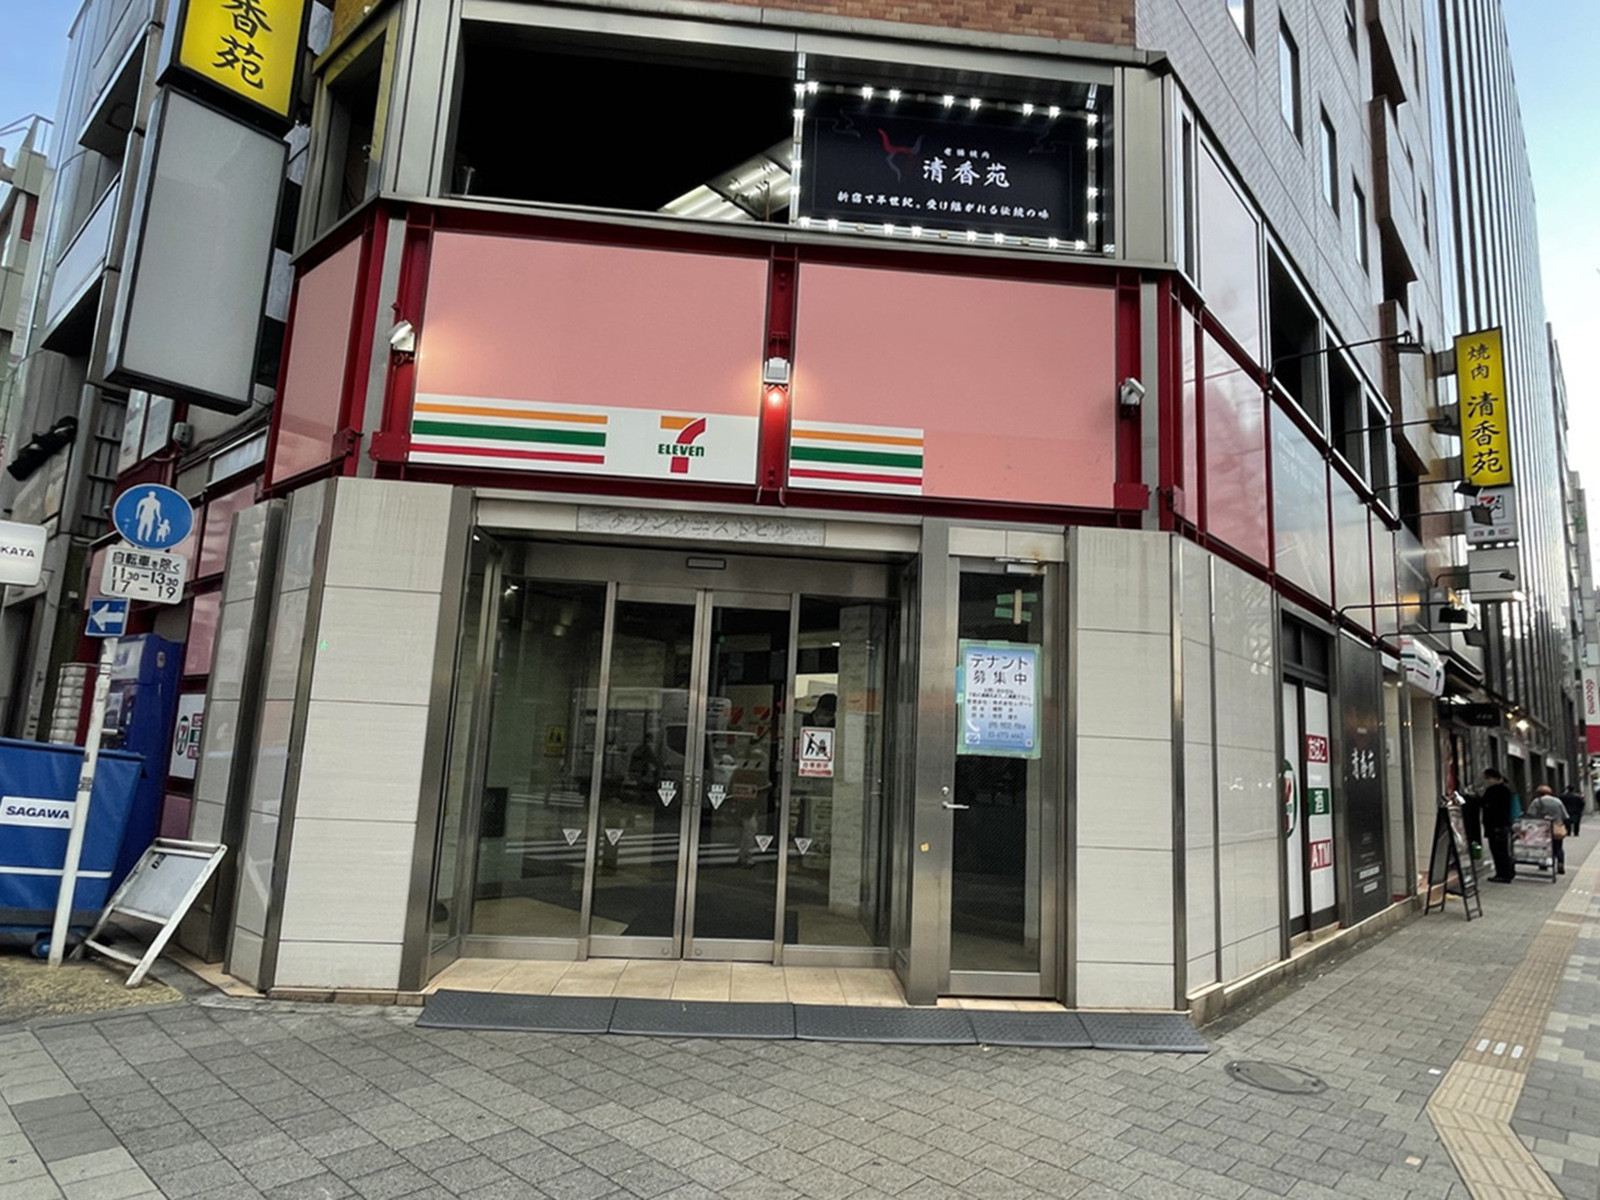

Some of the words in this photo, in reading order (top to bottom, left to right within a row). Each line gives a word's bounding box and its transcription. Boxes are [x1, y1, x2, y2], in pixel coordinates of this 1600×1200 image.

[212, 0, 273, 90] 香苑
[922, 156, 1011, 188] 清香苑
[1467, 343, 1491, 380] 焼肉
[1467, 391, 1503, 477] 清香苑
[971, 654, 1028, 670] テナント
[974, 670, 1027, 685] 募集中
[5, 804, 70, 820] SAGAWA
